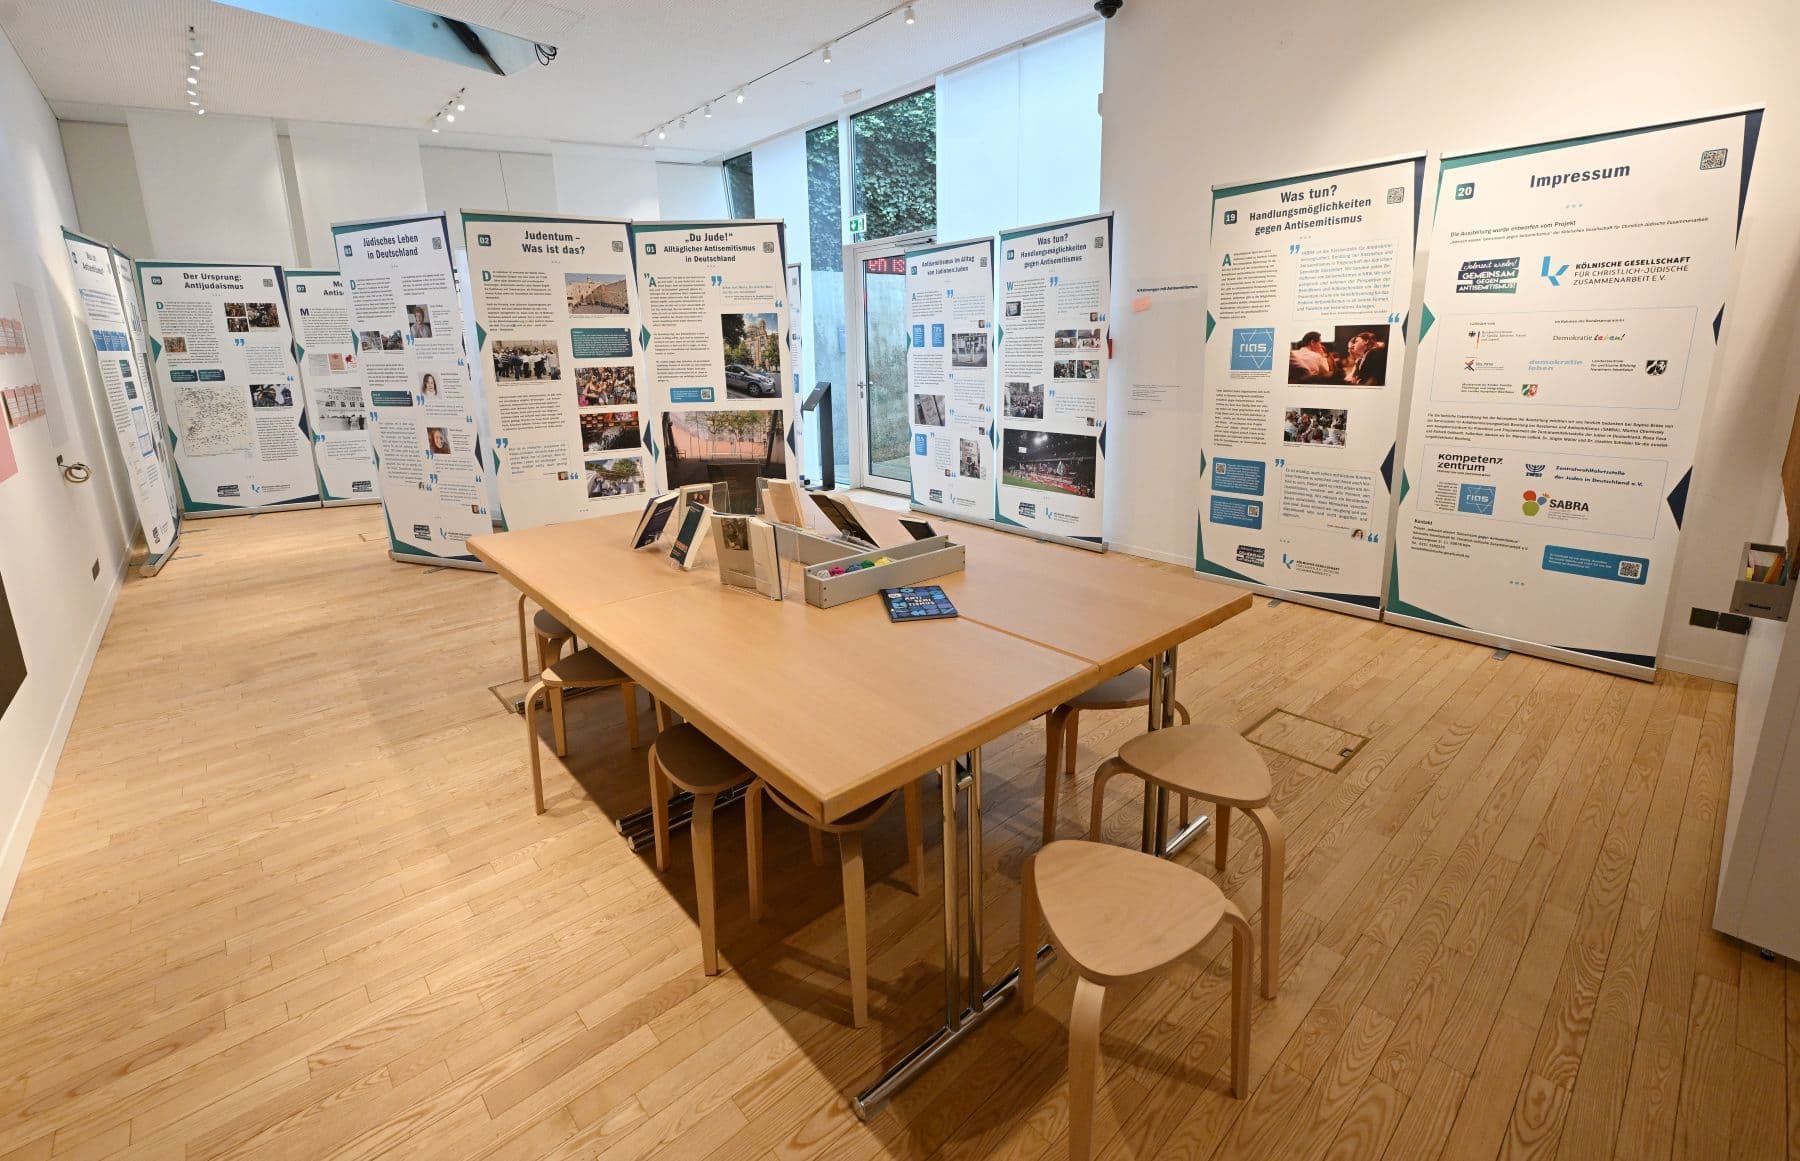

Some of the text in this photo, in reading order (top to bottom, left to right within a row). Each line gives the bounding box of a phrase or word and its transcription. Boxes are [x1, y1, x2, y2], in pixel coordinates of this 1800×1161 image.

[1529, 165, 1631, 189] Impressum
[1280, 184, 1338, 204] Was tun?
[1458, 186, 1473, 198] 20
[1249, 198, 1372, 222] Handlungsmöglichkeiten
[1225, 212, 1236, 223] 19
[1254, 213, 1363, 236] gegen Antisemitismus
[1554, 220, 1576, 228] Projekt
[363, 233, 419, 247] Jüdisches Leben
[479, 236, 490, 245] 02
[524, 230, 574, 242] Judentum
[685, 232, 734, 243] „Du Jude!“
[1037, 233, 1069, 246] Was tun?
[367, 246, 419, 260] in Deutschland
[522, 243, 586, 255] Was ist das?
[664, 243, 756, 254] Alltäglicher Antisemitismus
[694, 255, 736, 263] Deutschland
[1024, 255, 1083, 269] gegen Antisemitismus
[1576, 256, 1691, 270] KÖLNISCHE GESELLSCHAFT
[183, 272, 242, 282] Der Ursprung:
[1462, 270, 1516, 280] GEMEINSAM
[1574, 264, 1689, 278] FÜR CHRISTLICH-JÜDISCHE
[184, 282, 244, 290] Antijudaismus
[1476, 277, 1499, 285] GEGEN
[1573, 275, 1650, 286] ZUSAMMENARBEIT
[1592, 477, 1630, 486] Deutschland
[1549, 498, 1590, 512] SABRA
